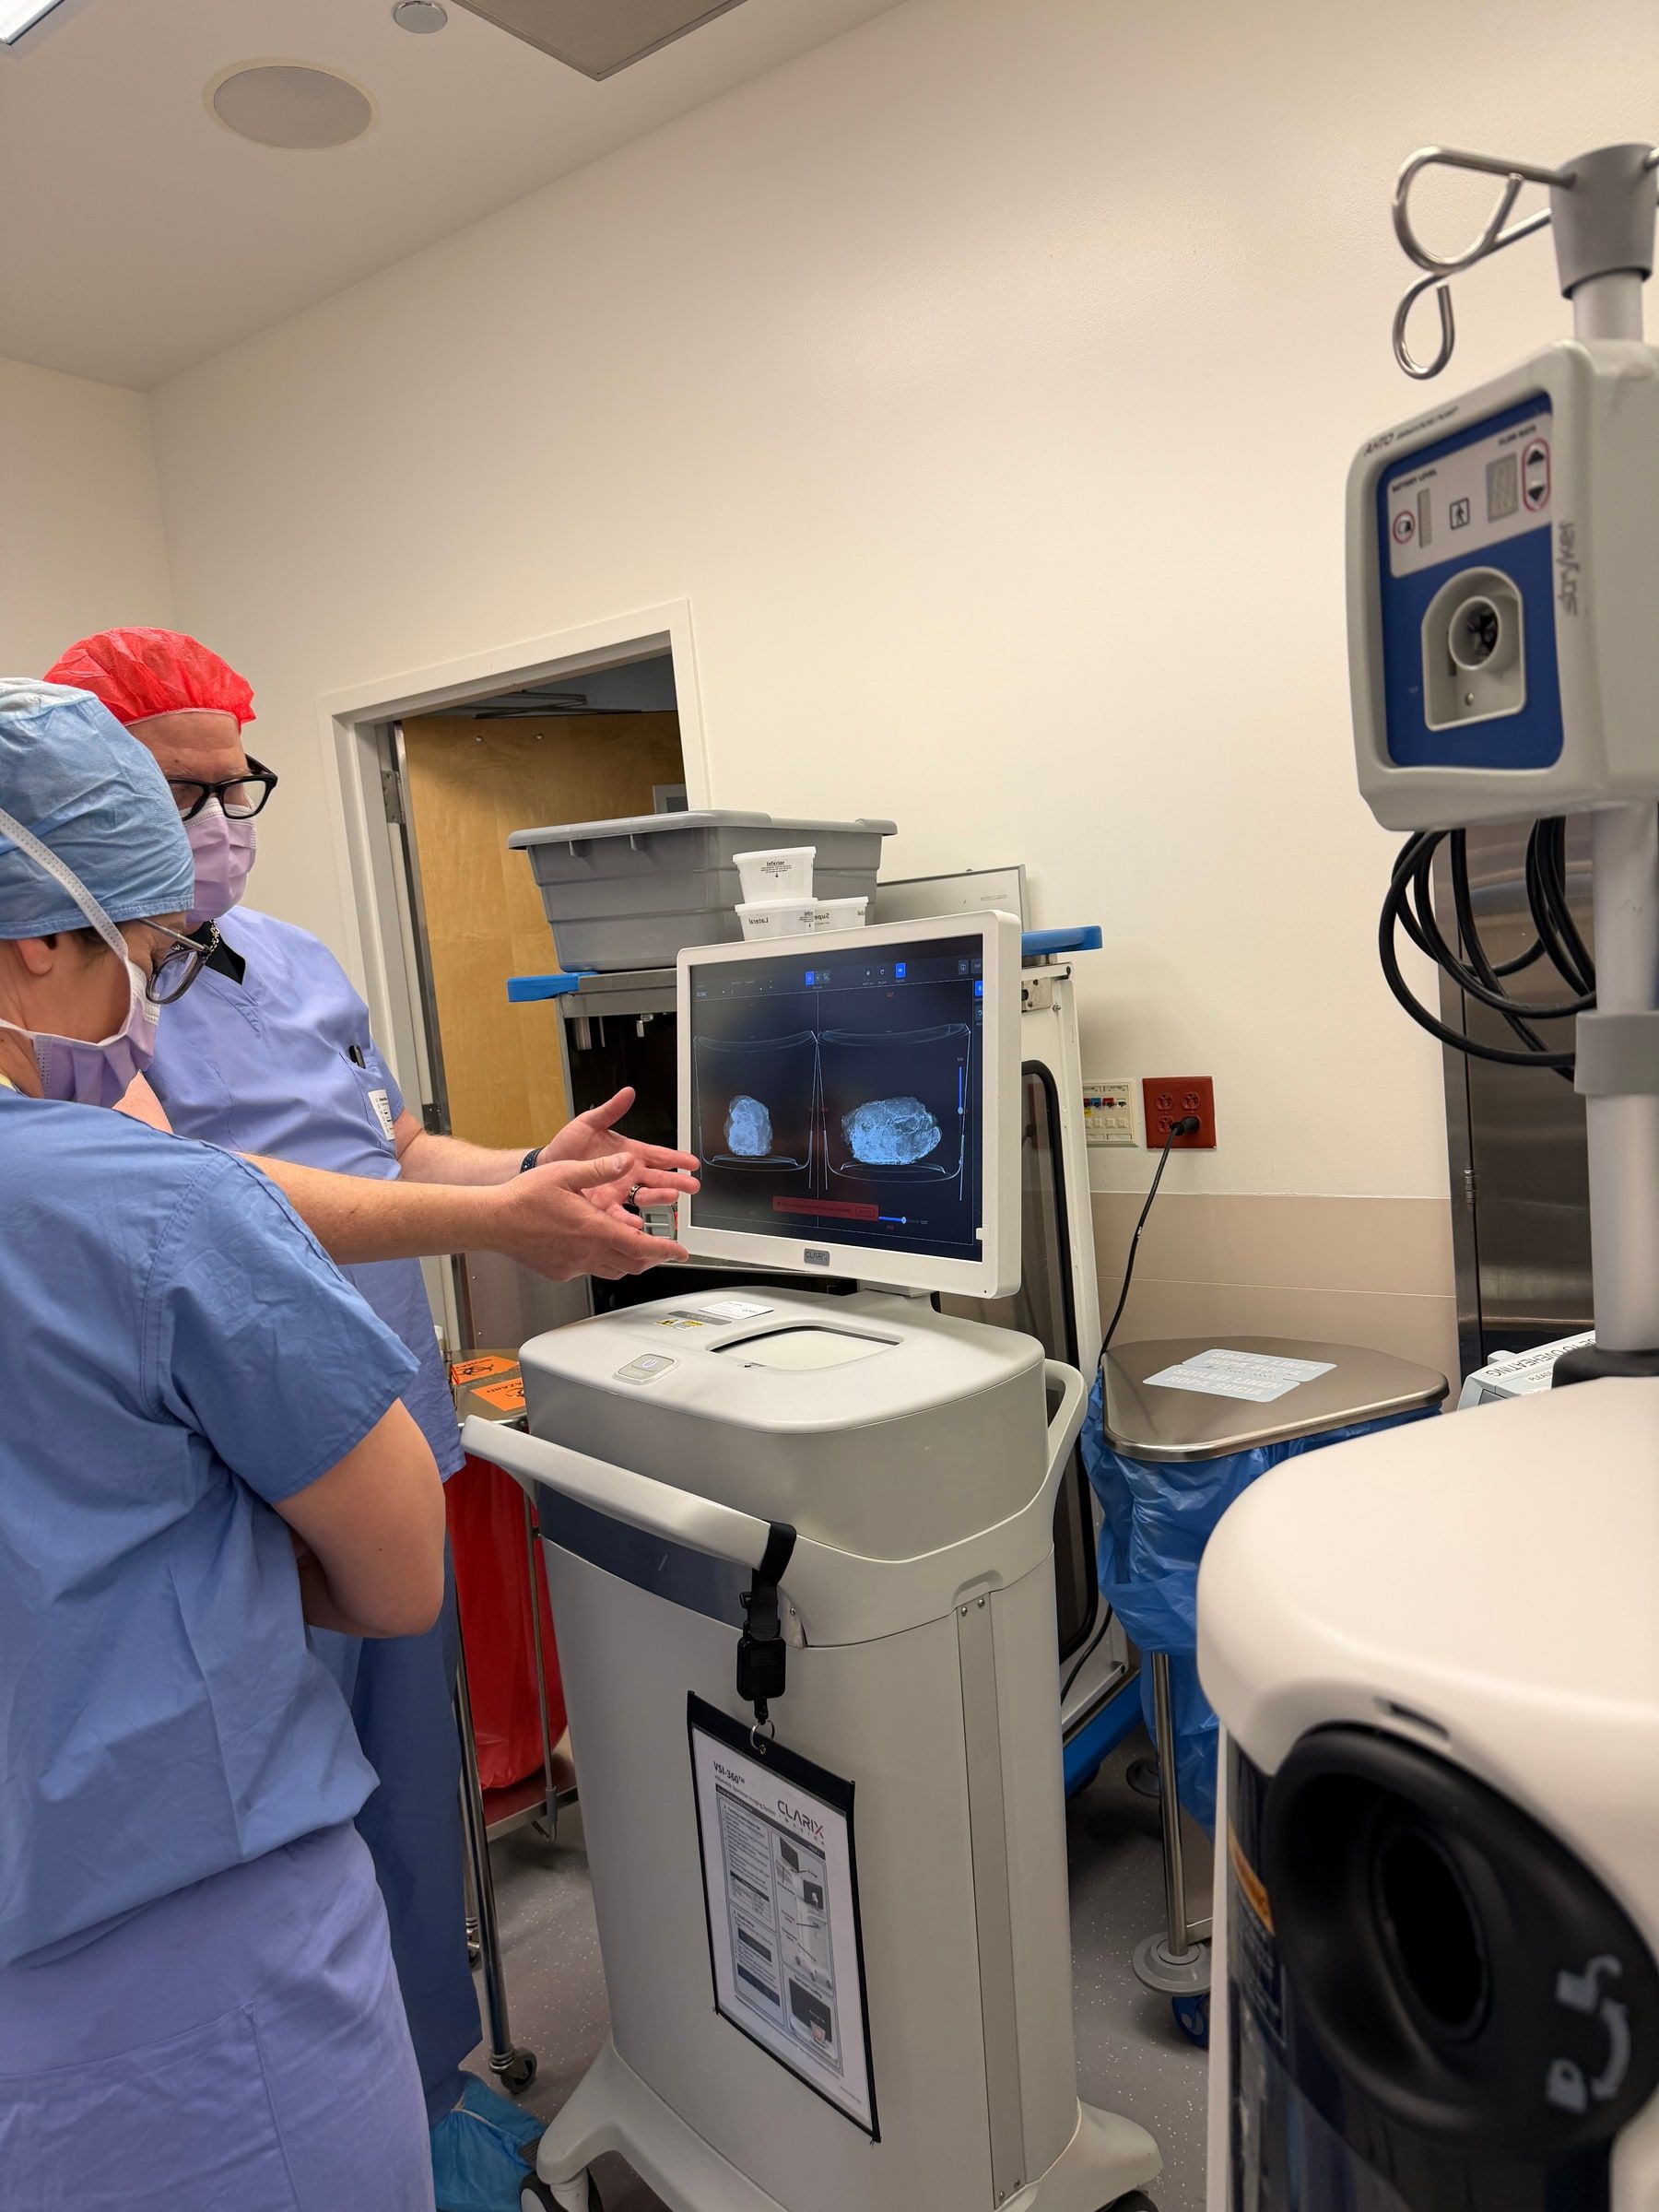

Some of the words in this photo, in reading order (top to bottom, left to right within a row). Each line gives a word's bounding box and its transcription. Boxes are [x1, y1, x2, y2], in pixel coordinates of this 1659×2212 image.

[1557, 522, 1580, 617] stryker
[1205, 1358, 1245, 1369] ROPA
[1251, 1365, 1302, 1377] SUCIA
[1211, 1352, 1267, 1364] SOILED
[1273, 1359, 1320, 1371] LINEN
[1165, 1376, 1208, 1388] ROPA
[1212, 1382, 1264, 1395] SUCIA
[1174, 1369, 1230, 1382] SOILED
[1231, 1376, 1284, 1390] LINEN
[777, 1799, 824, 1841] CLARIX
